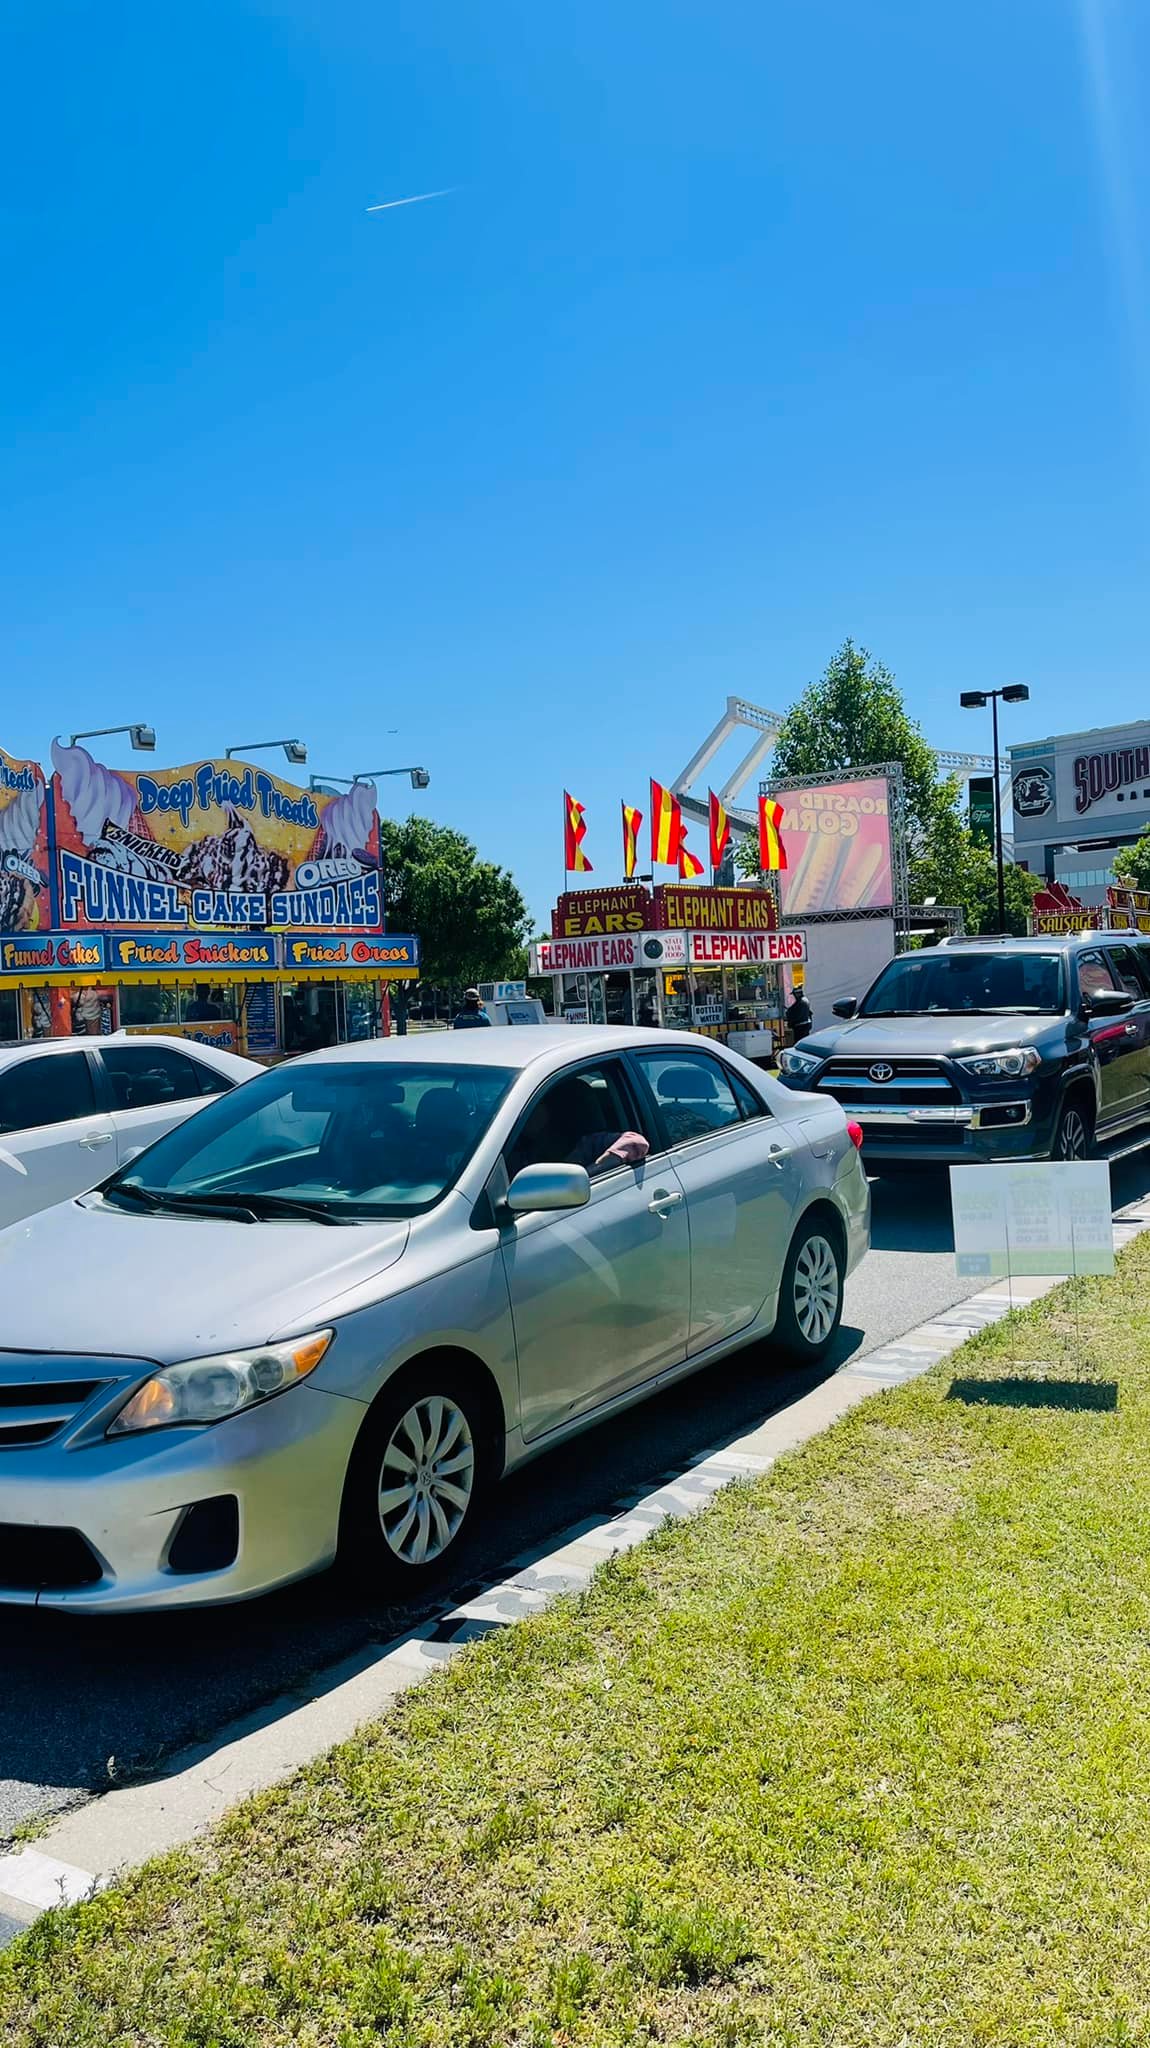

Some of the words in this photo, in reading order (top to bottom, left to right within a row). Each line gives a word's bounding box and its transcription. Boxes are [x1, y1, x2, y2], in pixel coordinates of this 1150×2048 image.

[0, 762, 35, 792] reats
[137, 774, 194, 828] Deep
[195, 762, 255, 811] Fried
[256, 772, 320, 829] Treats
[105, 829, 182, 868] SNICKERS
[4, 854, 42, 884] OREO
[295, 859, 362, 889] OREO
[61, 850, 187, 923] FUNNEL
[191, 891, 267, 925] CAKE
[272, 870, 380, 927] SUNDAES
[568, 895, 637, 915] ELEPHANT
[666, 895, 734, 929] ELEPHANT
[737, 899, 769, 929] EARS
[564, 911, 644, 936] EARS
[1040, 914, 1095, 932] SAUSAGE
[4, 943, 54, 967] Funnel
[57, 940, 100, 965] Cakes
[119, 940, 179, 964] Fried
[184, 939, 269, 963] Snickers
[291, 942, 348, 963] Fried
[351, 941, 409, 962] Oreos
[541, 941, 599, 970] ELEPHANT
[602, 938, 634, 967] EARS
[665, 951, 685, 959] FOODS
[693, 934, 764, 961] ELEPHANT
[768, 934, 803, 960] EARS
[696, 1005, 722, 1014] BOTTLED
[700, 1014, 720, 1023] WATER
